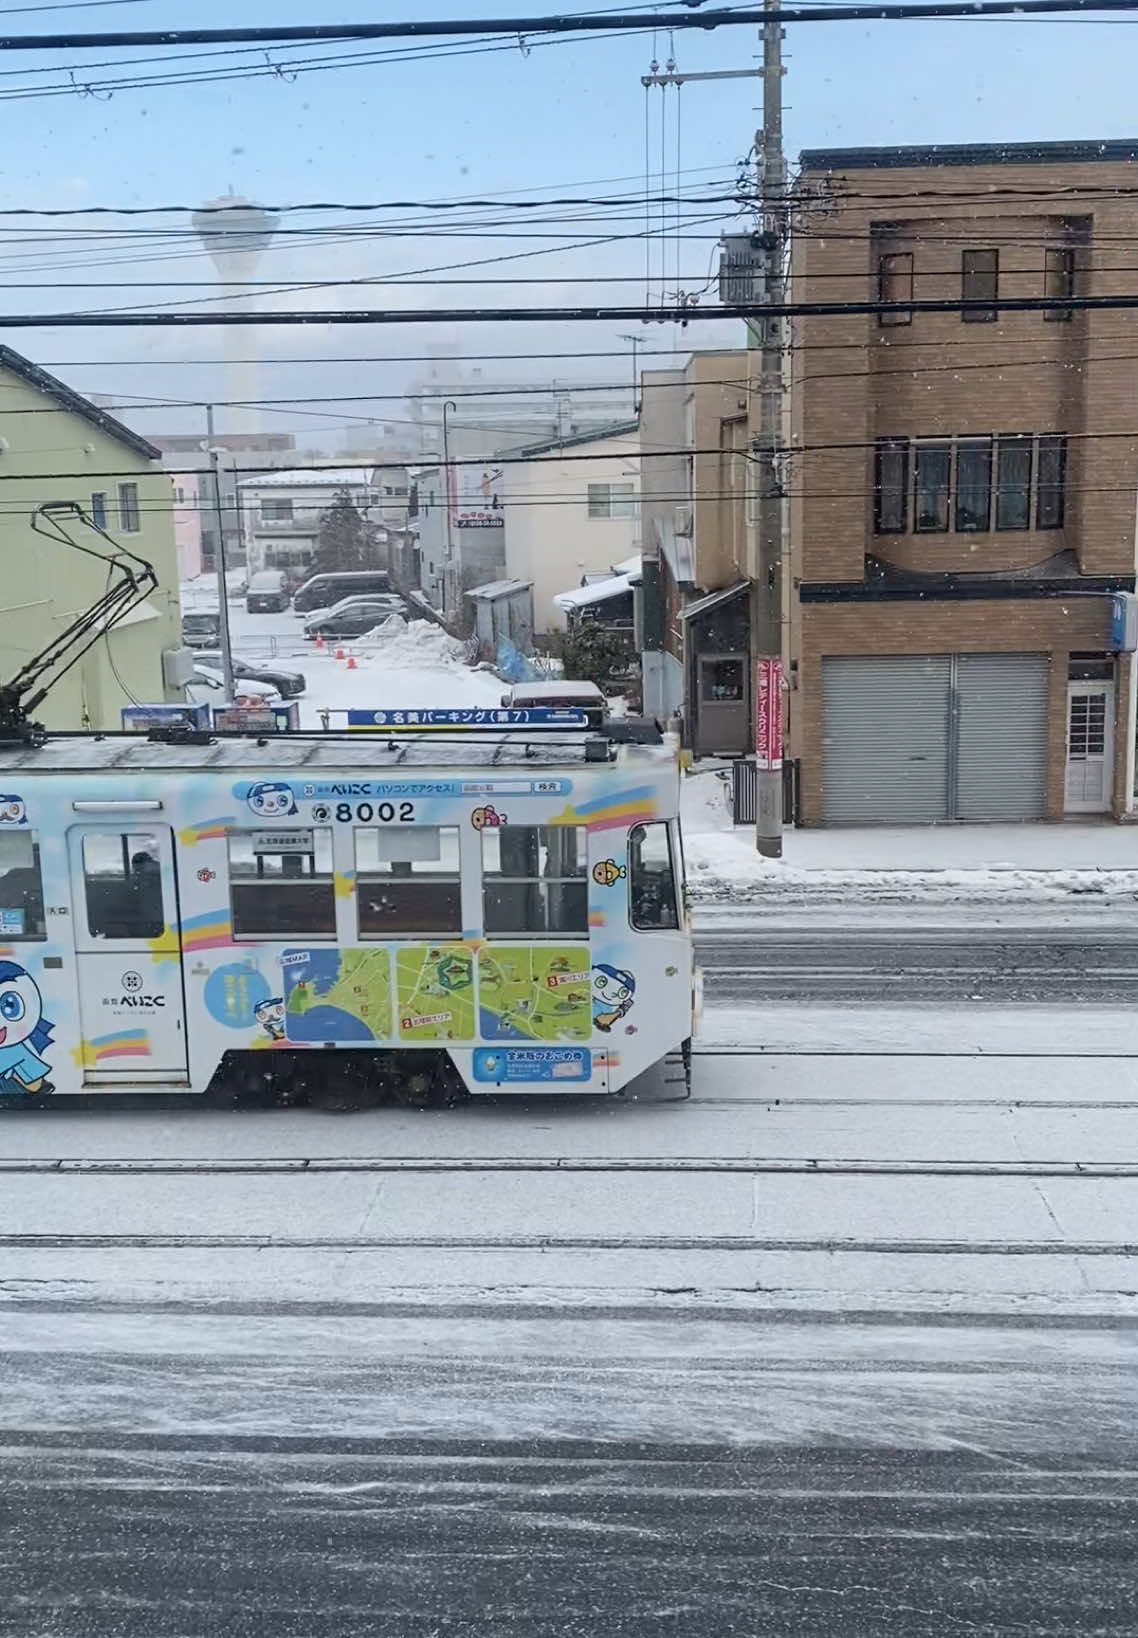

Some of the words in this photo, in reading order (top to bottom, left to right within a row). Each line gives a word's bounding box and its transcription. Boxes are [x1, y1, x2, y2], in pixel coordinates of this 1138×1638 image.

[331, 783, 371, 795] べいこく
[336, 803, 416, 822] 8002
[121, 996, 165, 1007] べいこく
